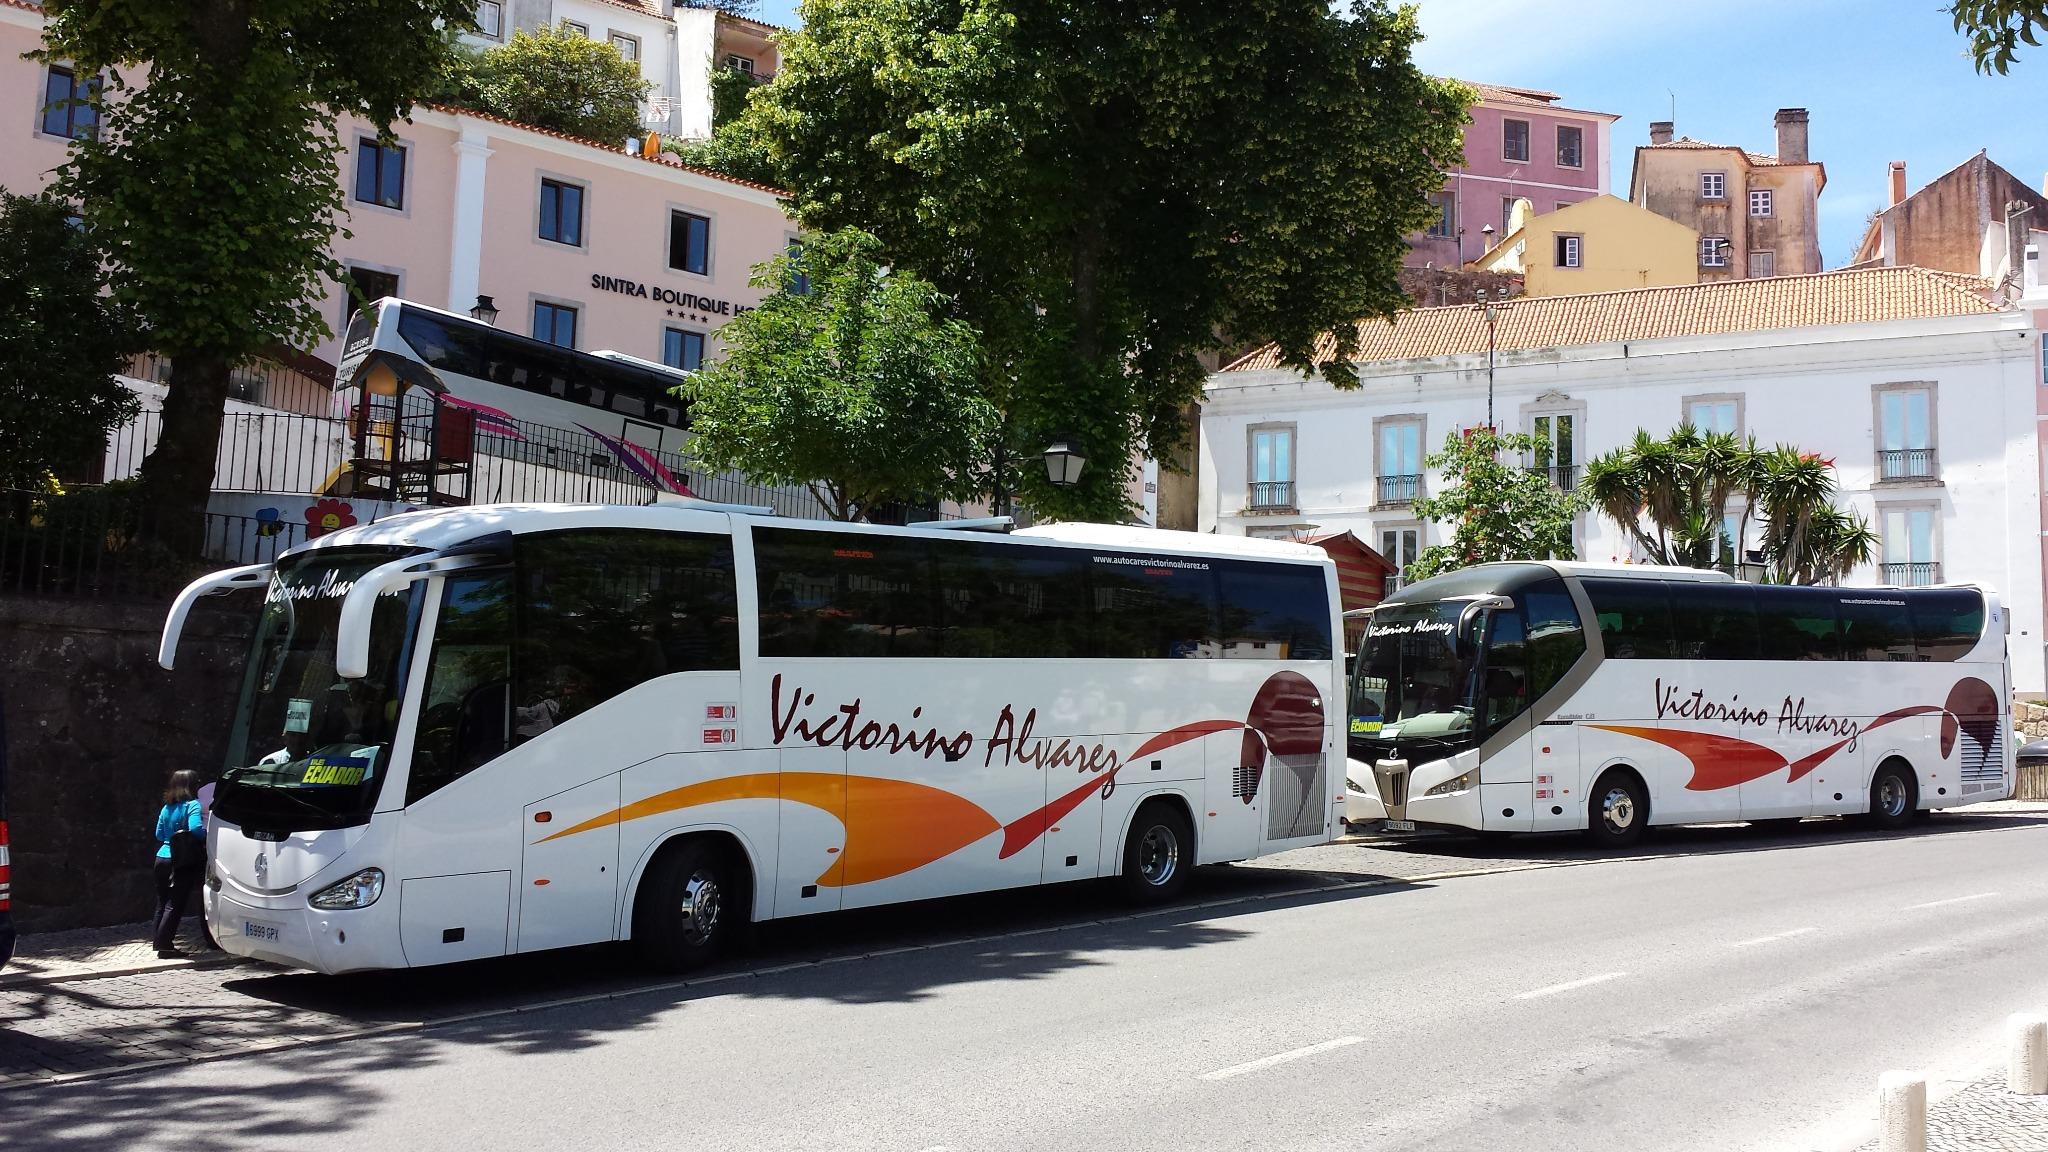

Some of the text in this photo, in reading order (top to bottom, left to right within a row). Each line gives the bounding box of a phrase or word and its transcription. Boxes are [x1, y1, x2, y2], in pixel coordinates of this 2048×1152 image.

[591, 273, 648, 299] SINTRA
[652, 286, 730, 316] BOUTIQUE
[1093, 555, 1210, 570] www.autocaresvictorinoalvarez.es
[1369, 618, 1455, 638] Victorino Alvarez
[1655, 677, 1863, 753] Victorino Alvarez
[771, 673, 1124, 800] Victorino Alvarez
[1350, 721, 1382, 733] ECUADOR
[302, 765, 365, 785] ECUADOR
